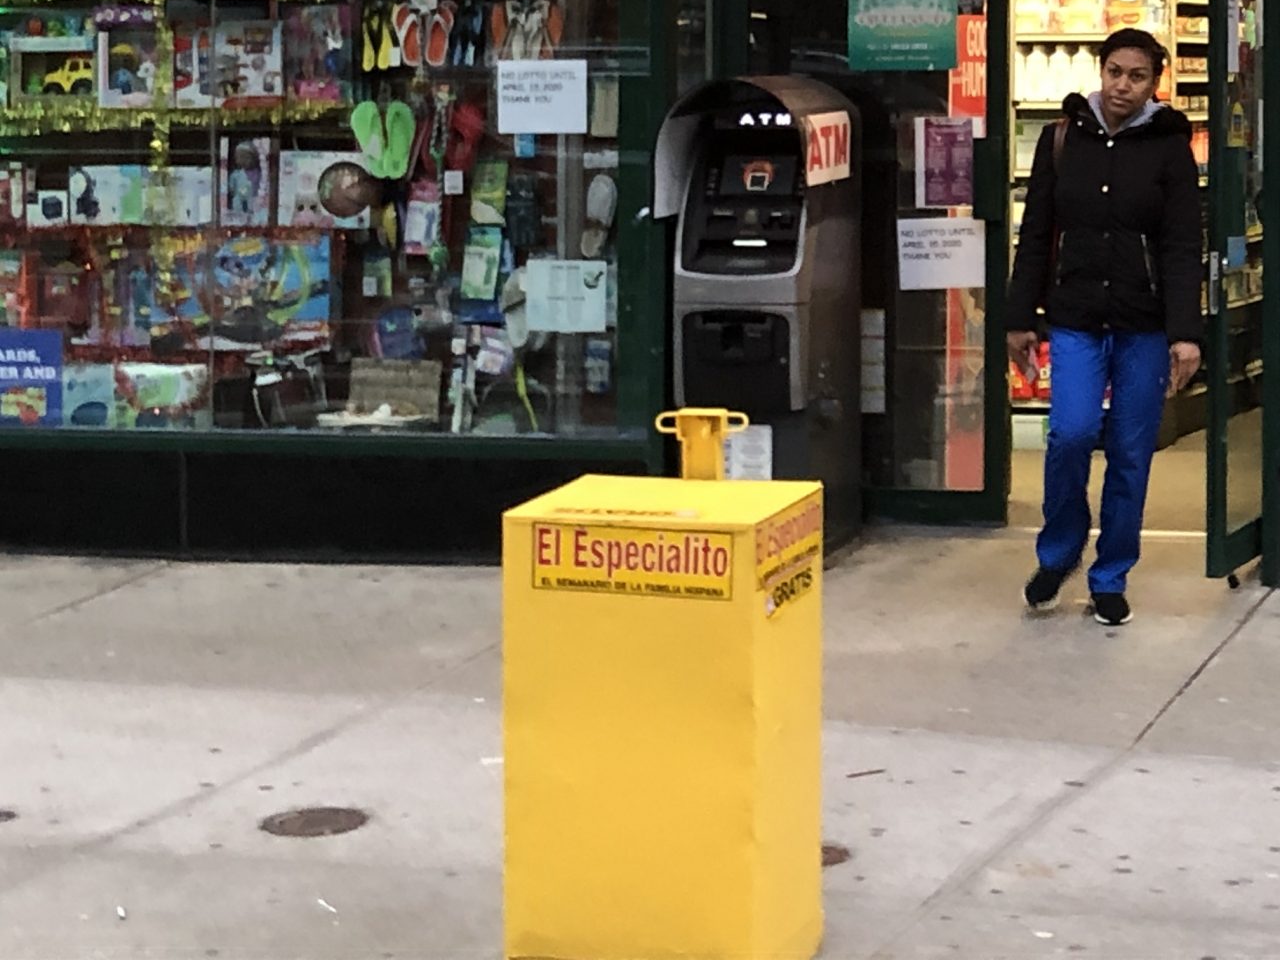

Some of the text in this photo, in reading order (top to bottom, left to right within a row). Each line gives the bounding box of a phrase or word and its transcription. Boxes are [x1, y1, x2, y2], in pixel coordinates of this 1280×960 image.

[739, 113, 792, 126] ATM
[808, 123, 849, 173] ATM
[23, 367, 56, 380] AND
[538, 527, 561, 566] El
[573, 528, 728, 579] Especialito
[614, 580, 626, 591] DE
[630, 582, 643, 592] LA
